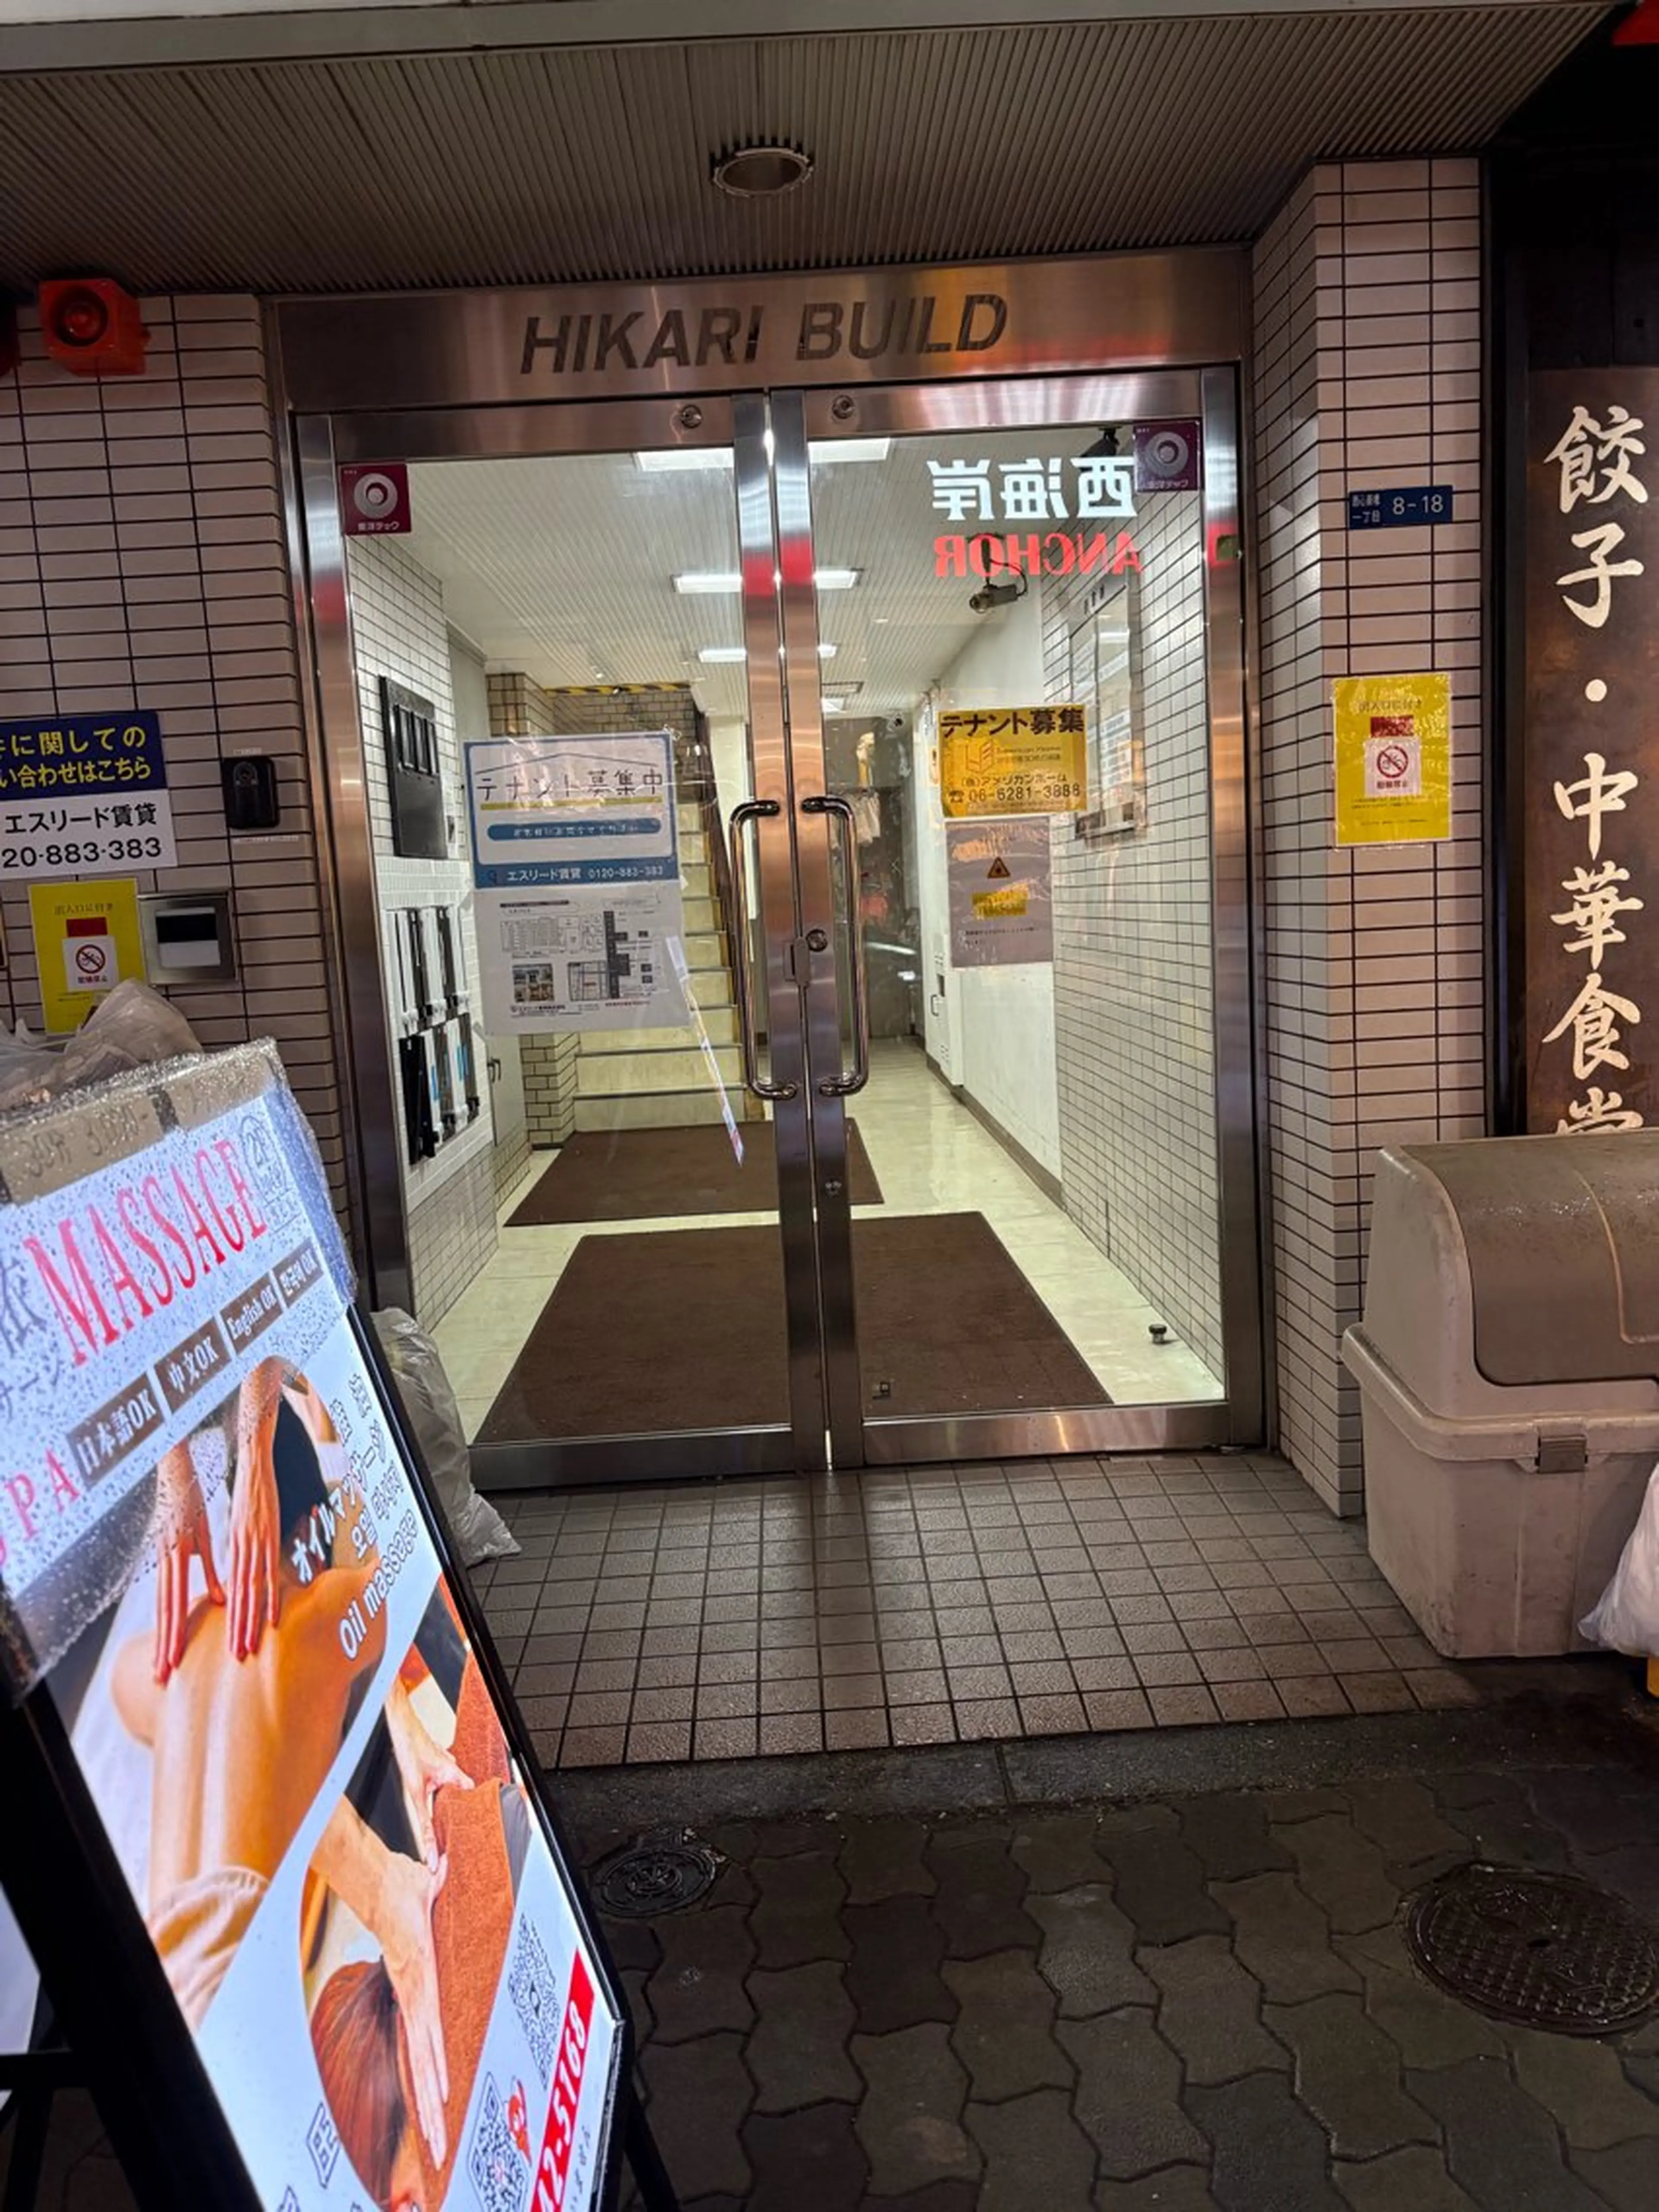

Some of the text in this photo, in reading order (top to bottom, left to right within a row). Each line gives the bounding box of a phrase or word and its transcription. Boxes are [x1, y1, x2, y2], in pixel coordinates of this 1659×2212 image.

[520, 294, 1008, 374] HIKARI BUILD
[1393, 494, 1443, 515] 8-18
[941, 708, 1085, 738] テナント募集
[477, 769, 663, 801] テナント募集中
[5, 802, 156, 834] エスリード賃貸
[507, 867, 582, 881] エスリード賃貸
[23, 1139, 267, 1367] MASSAGE
[226, 1298, 265, 1340] English
[168, 1336, 219, 1394] 中文OK
[76, 1389, 157, 1476] 日本語OK
[292, 1418, 387, 1584] オイルマッサージ
[350, 1505, 379, 1559] 오일
[339, 1509, 419, 1660] Oil massage
